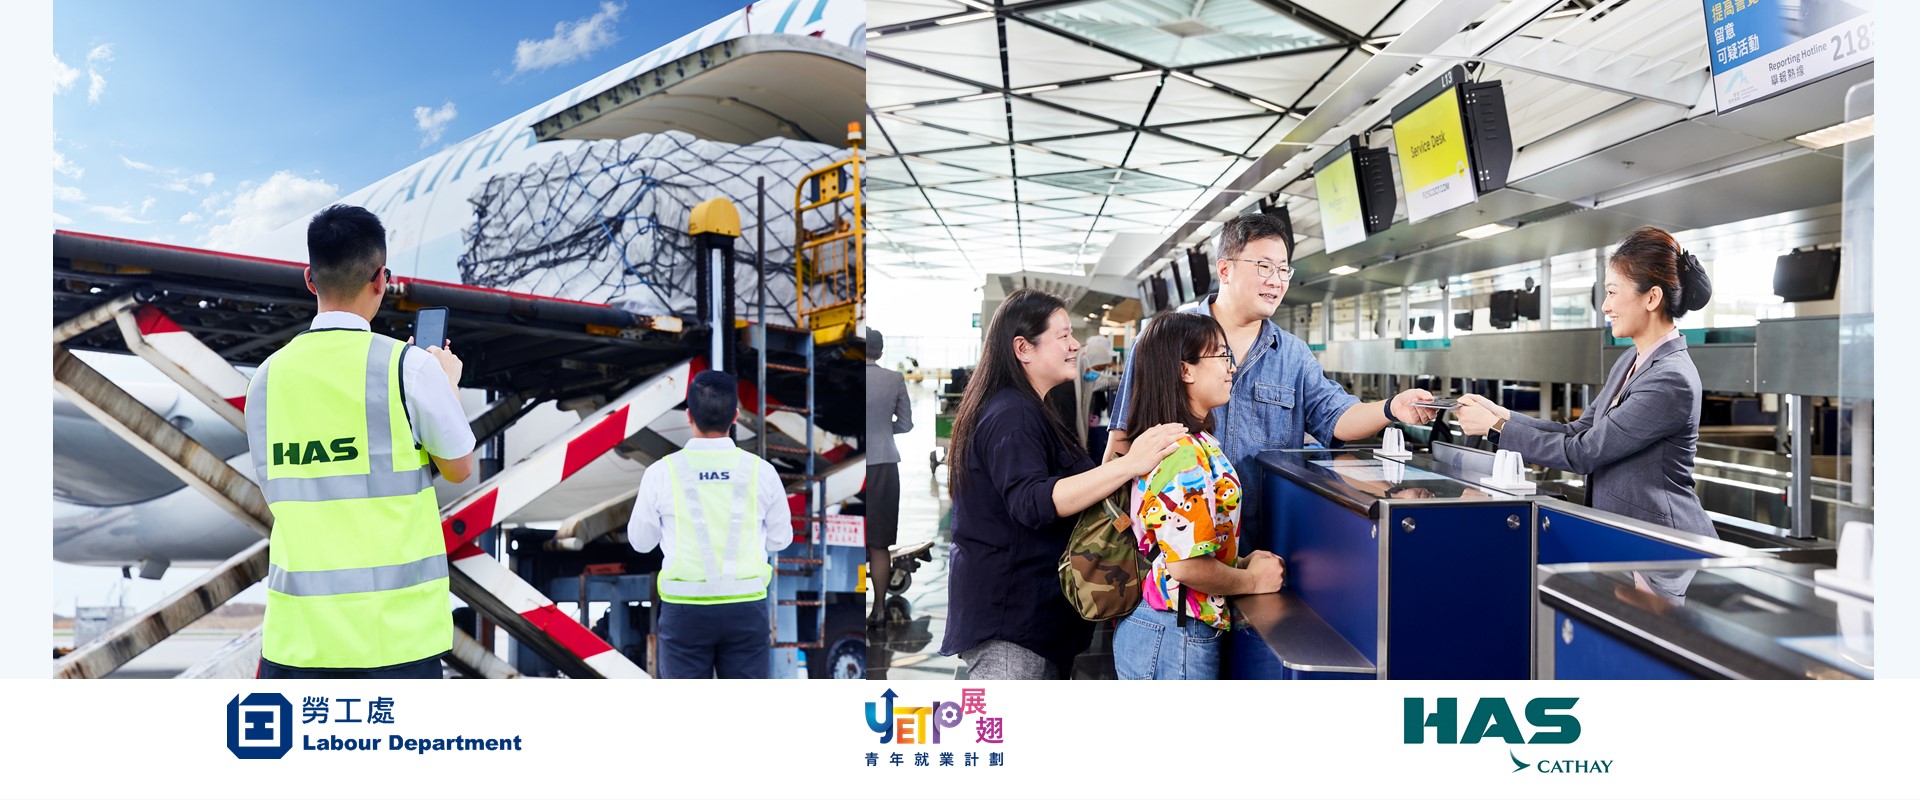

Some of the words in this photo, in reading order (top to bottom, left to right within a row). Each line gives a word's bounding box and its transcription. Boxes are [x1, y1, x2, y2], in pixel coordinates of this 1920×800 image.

[1714, 22, 1735, 45] 留意
[1768, 54, 1801, 71] Reporting
[1801, 42, 1828, 60] Hotline
[1831, 20, 1874, 61] 218
[1717, 33, 1760, 65] 可疑活動
[1441, 71, 1453, 88] L13
[1410, 139, 1431, 158] Service
[1431, 130, 1446, 148] Desk
[273, 437, 358, 465] HAS
[699, 471, 729, 480] HAS
